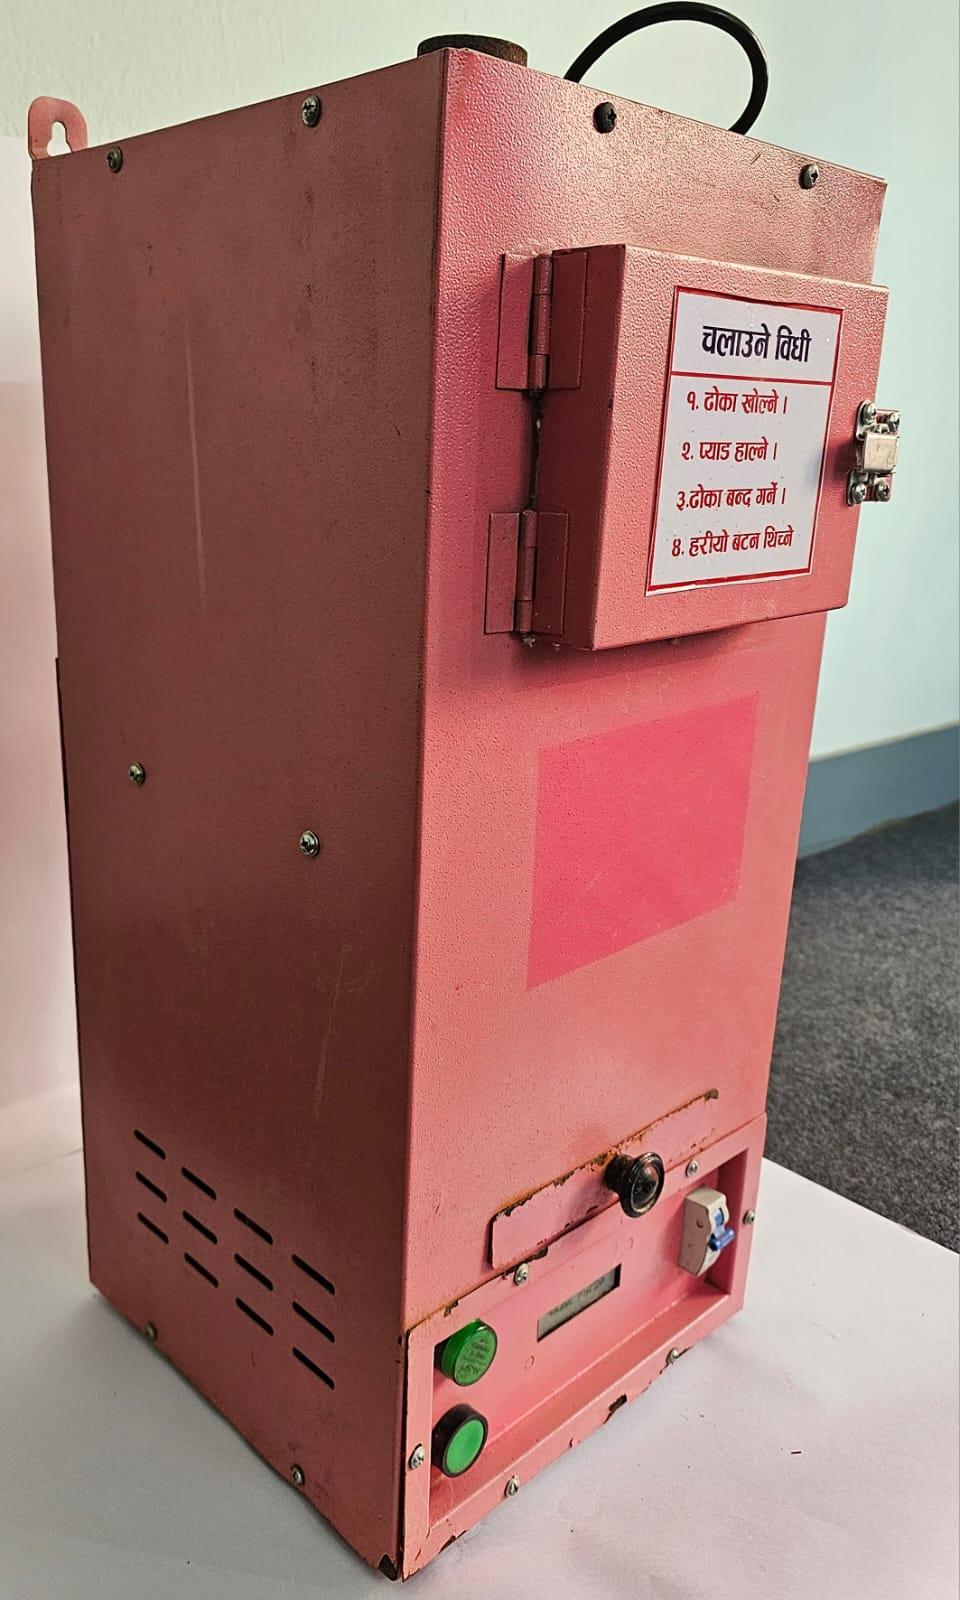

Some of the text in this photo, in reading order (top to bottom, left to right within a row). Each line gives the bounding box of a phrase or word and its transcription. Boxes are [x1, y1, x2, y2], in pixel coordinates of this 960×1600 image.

[702, 323, 771, 359] चलाउने
[687, 391, 699, 411] १.
[703, 385, 739, 412] ढोका
[741, 388, 779, 414] खोल्ने
[681, 442, 694, 460] २.
[699, 442, 732, 460] प्याड
[734, 436, 768, 462] हाल्ने
[726, 487, 753, 507] बन्द
[756, 482, 778, 505] गर्ने
[671, 525, 795, 557] ४. हरीयो बटन थिच्ने
